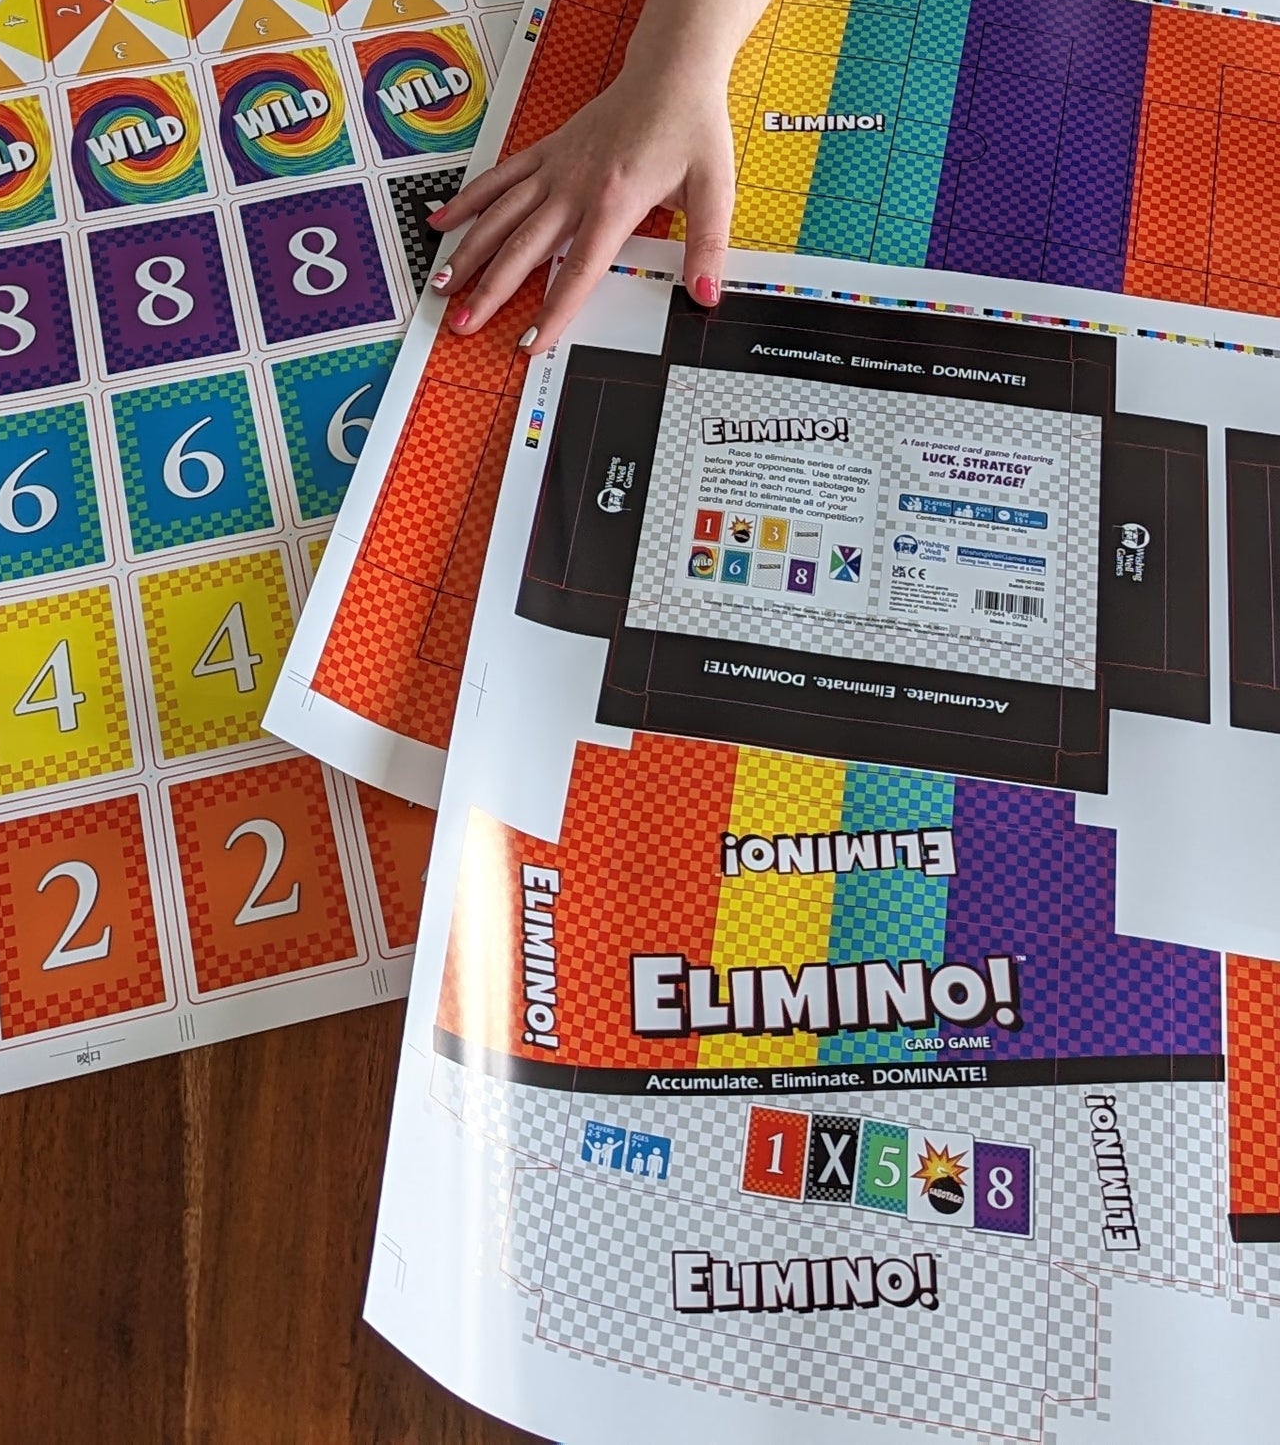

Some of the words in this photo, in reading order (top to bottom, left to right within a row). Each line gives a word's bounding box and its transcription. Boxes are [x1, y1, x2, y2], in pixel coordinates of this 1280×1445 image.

[233, 89, 330, 140] WILD
[376, 66, 472, 116] WILD
[86, 115, 186, 166] WILD
[763, 111, 885, 133] ELIMINO!
[288, 226, 349, 297] 8
[135, 256, 195, 327] 8
[751, 343, 845, 365] Accumulate.
[851, 356, 926, 374] Eliminate.
[932, 365, 1026, 387] DOMINATE!
[702, 417, 849, 445] ELIMINO!
[901, 438, 908, 446] A
[911, 439, 961, 452] fast-paced
[962, 446, 983, 455] card
[984, 449, 1010, 459] game
[1012, 452, 1054, 465] featuring
[163, 416, 225, 500] 6
[705, 456, 733, 465] before
[735, 460, 756, 470] your
[757, 463, 807, 476] opponents.
[812, 469, 830, 479] Use
[728, 448, 752, 458] Race
[754, 451, 763, 459] to
[765, 453, 805, 465] eliminate
[807, 459, 835, 470] series
[836, 463, 846, 471] of
[847, 464, 872, 475] cards
[929, 469, 946, 478] and
[949, 469, 1026, 489] SABOTAGE!
[963, 457, 1032, 476] STRATEGY
[194, 603, 261, 692] 4
[14, 640, 85, 732] 4
[703, 659, 806, 687] DOMINATE!
[813, 675, 895, 698] Eliminate.
[904, 687, 1009, 714] Accumulate.
[226, 819, 299, 926] 2
[722, 827, 957, 877] ELIMINO!
[37, 861, 111, 971] 2
[521, 863, 560, 1050] ELIMINO!
[631, 953, 1023, 1038] ELIMINO!
[904, 1037, 945, 1051] CARD
[948, 1036, 992, 1050] GAME
[645, 1073, 764, 1091] Accumulate.
[771, 1070, 865, 1089] Eliminate.
[873, 1066, 988, 1085] DOMINATE!
[767, 1131, 785, 1175] 1
[821, 1132, 852, 1185] X
[875, 1146, 902, 1189] 5
[1084, 1094, 1141, 1252] ELIMINO!
[986, 1166, 1014, 1210] 8
[671, 1251, 940, 1314] ELIMINO!
